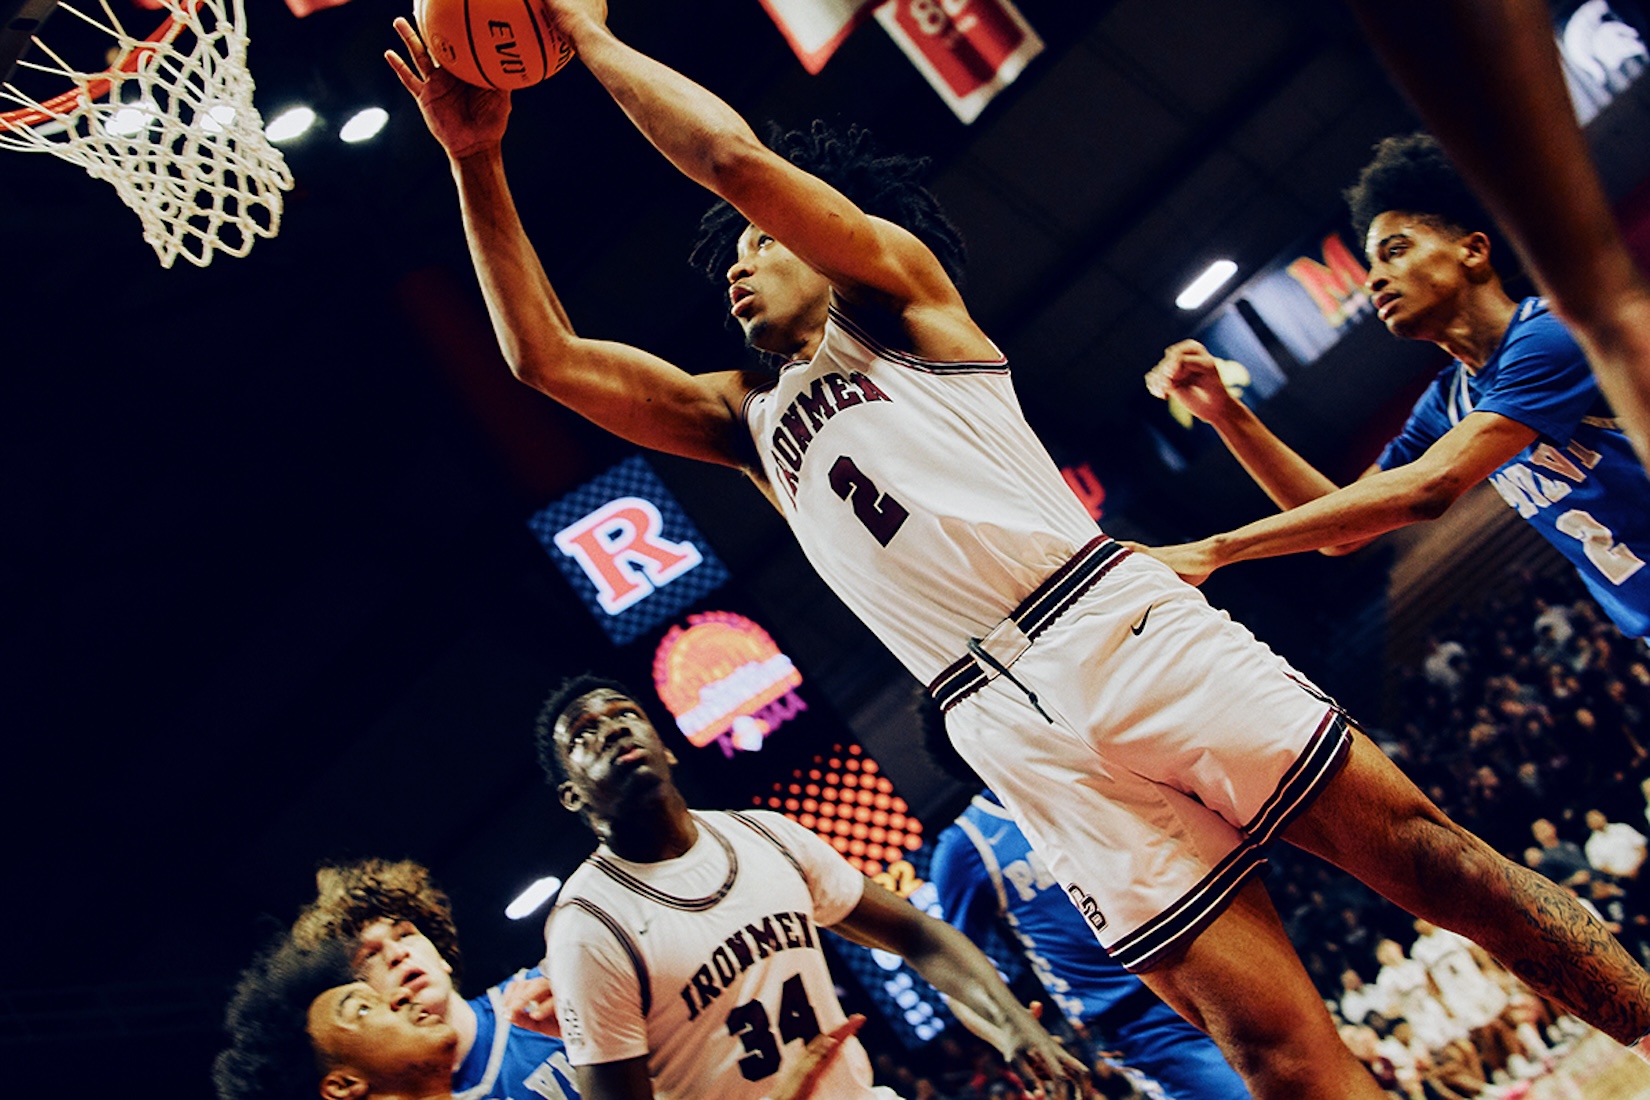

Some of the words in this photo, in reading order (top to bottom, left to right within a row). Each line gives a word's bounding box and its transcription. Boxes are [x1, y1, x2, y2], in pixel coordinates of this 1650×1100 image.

[488, 20, 526, 74] EVO
[828, 455, 910, 548] 2
[1556, 509, 1646, 586] 2
[553, 496, 703, 616] R
[726, 973, 821, 1082] 34
